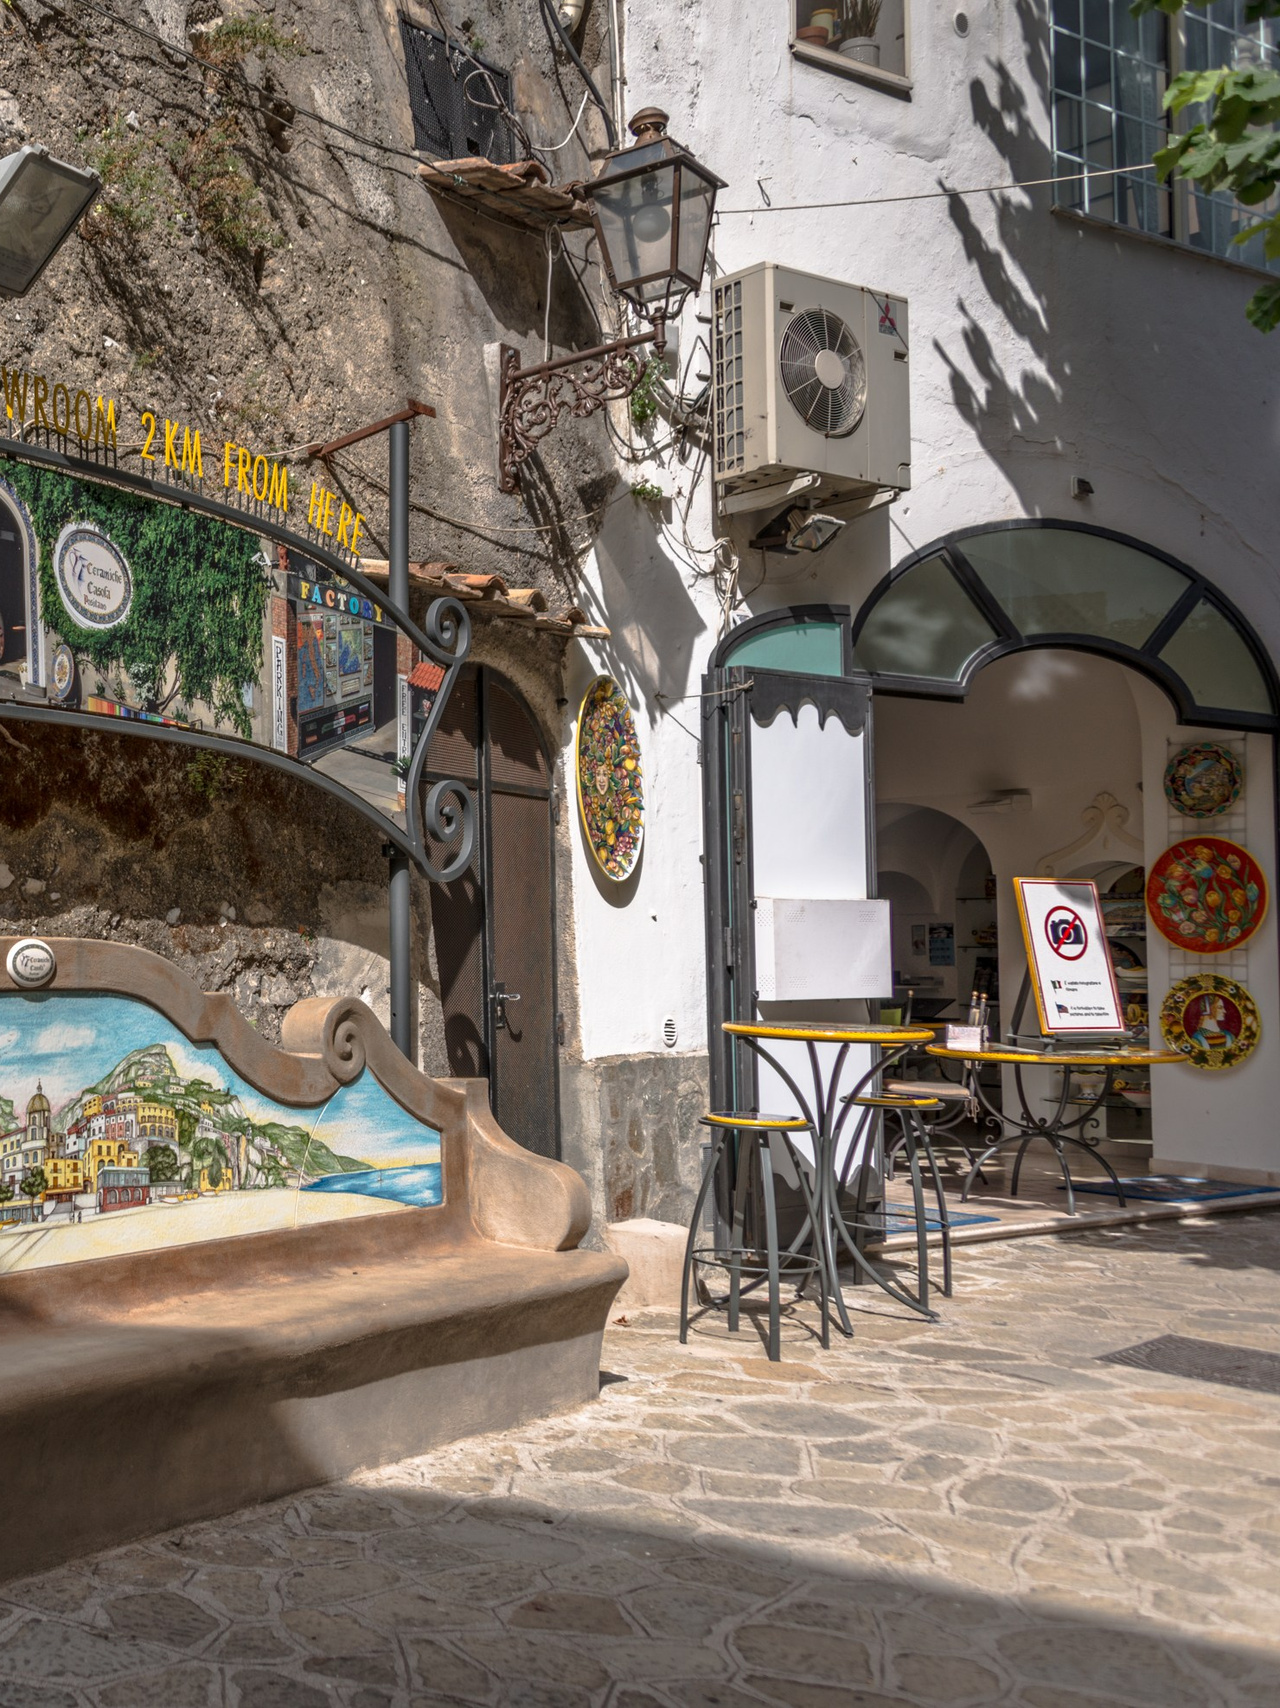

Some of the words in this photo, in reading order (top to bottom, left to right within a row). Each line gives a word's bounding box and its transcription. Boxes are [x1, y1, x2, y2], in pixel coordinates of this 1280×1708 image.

[223, 441, 288, 513] FROM
[306, 481, 366, 556] HERE
[86, 562, 122, 584] Ceramiche
[300, 581, 383, 623] FACTORY
[275, 645, 283, 737] PARKING
